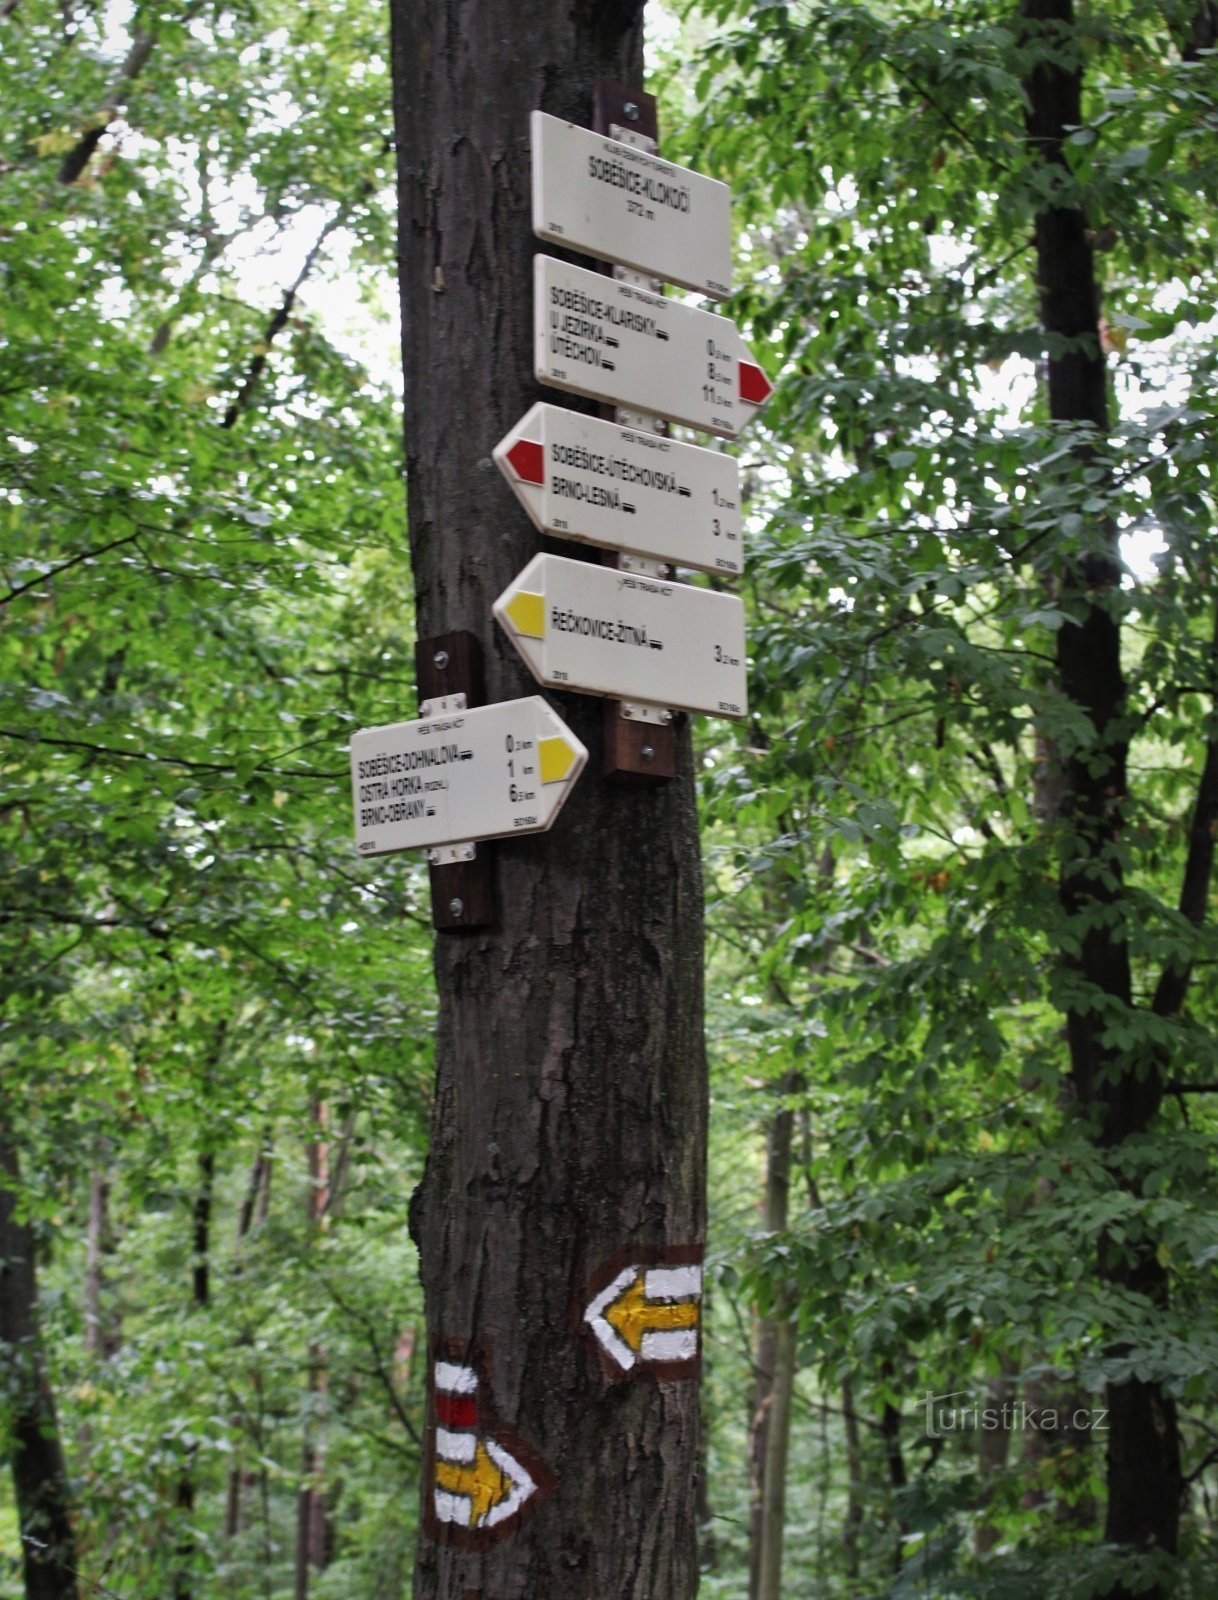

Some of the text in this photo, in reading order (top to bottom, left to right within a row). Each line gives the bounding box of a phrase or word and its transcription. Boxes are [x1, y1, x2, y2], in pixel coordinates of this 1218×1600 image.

[588, 154, 691, 215] SOBĚŠICE-KLOKOČÍ
[626, 199, 657, 221] 372 m
[550, 309, 559, 330] U
[722, 374, 733, 386] km
[550, 330, 602, 368] ÚTĚCHOV
[722, 396, 734, 409] km
[721, 351, 732, 363] km
[552, 442, 679, 494] SOBĚŠICE-ÚTĚCHOVSKÁ
[725, 499, 736, 511] km
[552, 475, 737, 541] BRNO-LESNÁ 3 km
[551, 605, 650, 648] ŘEČKOVICE-ŽITNÁ
[729, 656, 740, 668] km
[358, 743, 460, 779] SOBĚŠICE-DOHNALOVA
[521, 740, 533, 751] km
[389, 774, 424, 800] HORKA
[507, 759, 515, 778] 1
[523, 766, 534, 776] km
[360, 797, 426, 828] BRNO-OBŘANY
[525, 791, 536, 801] km
